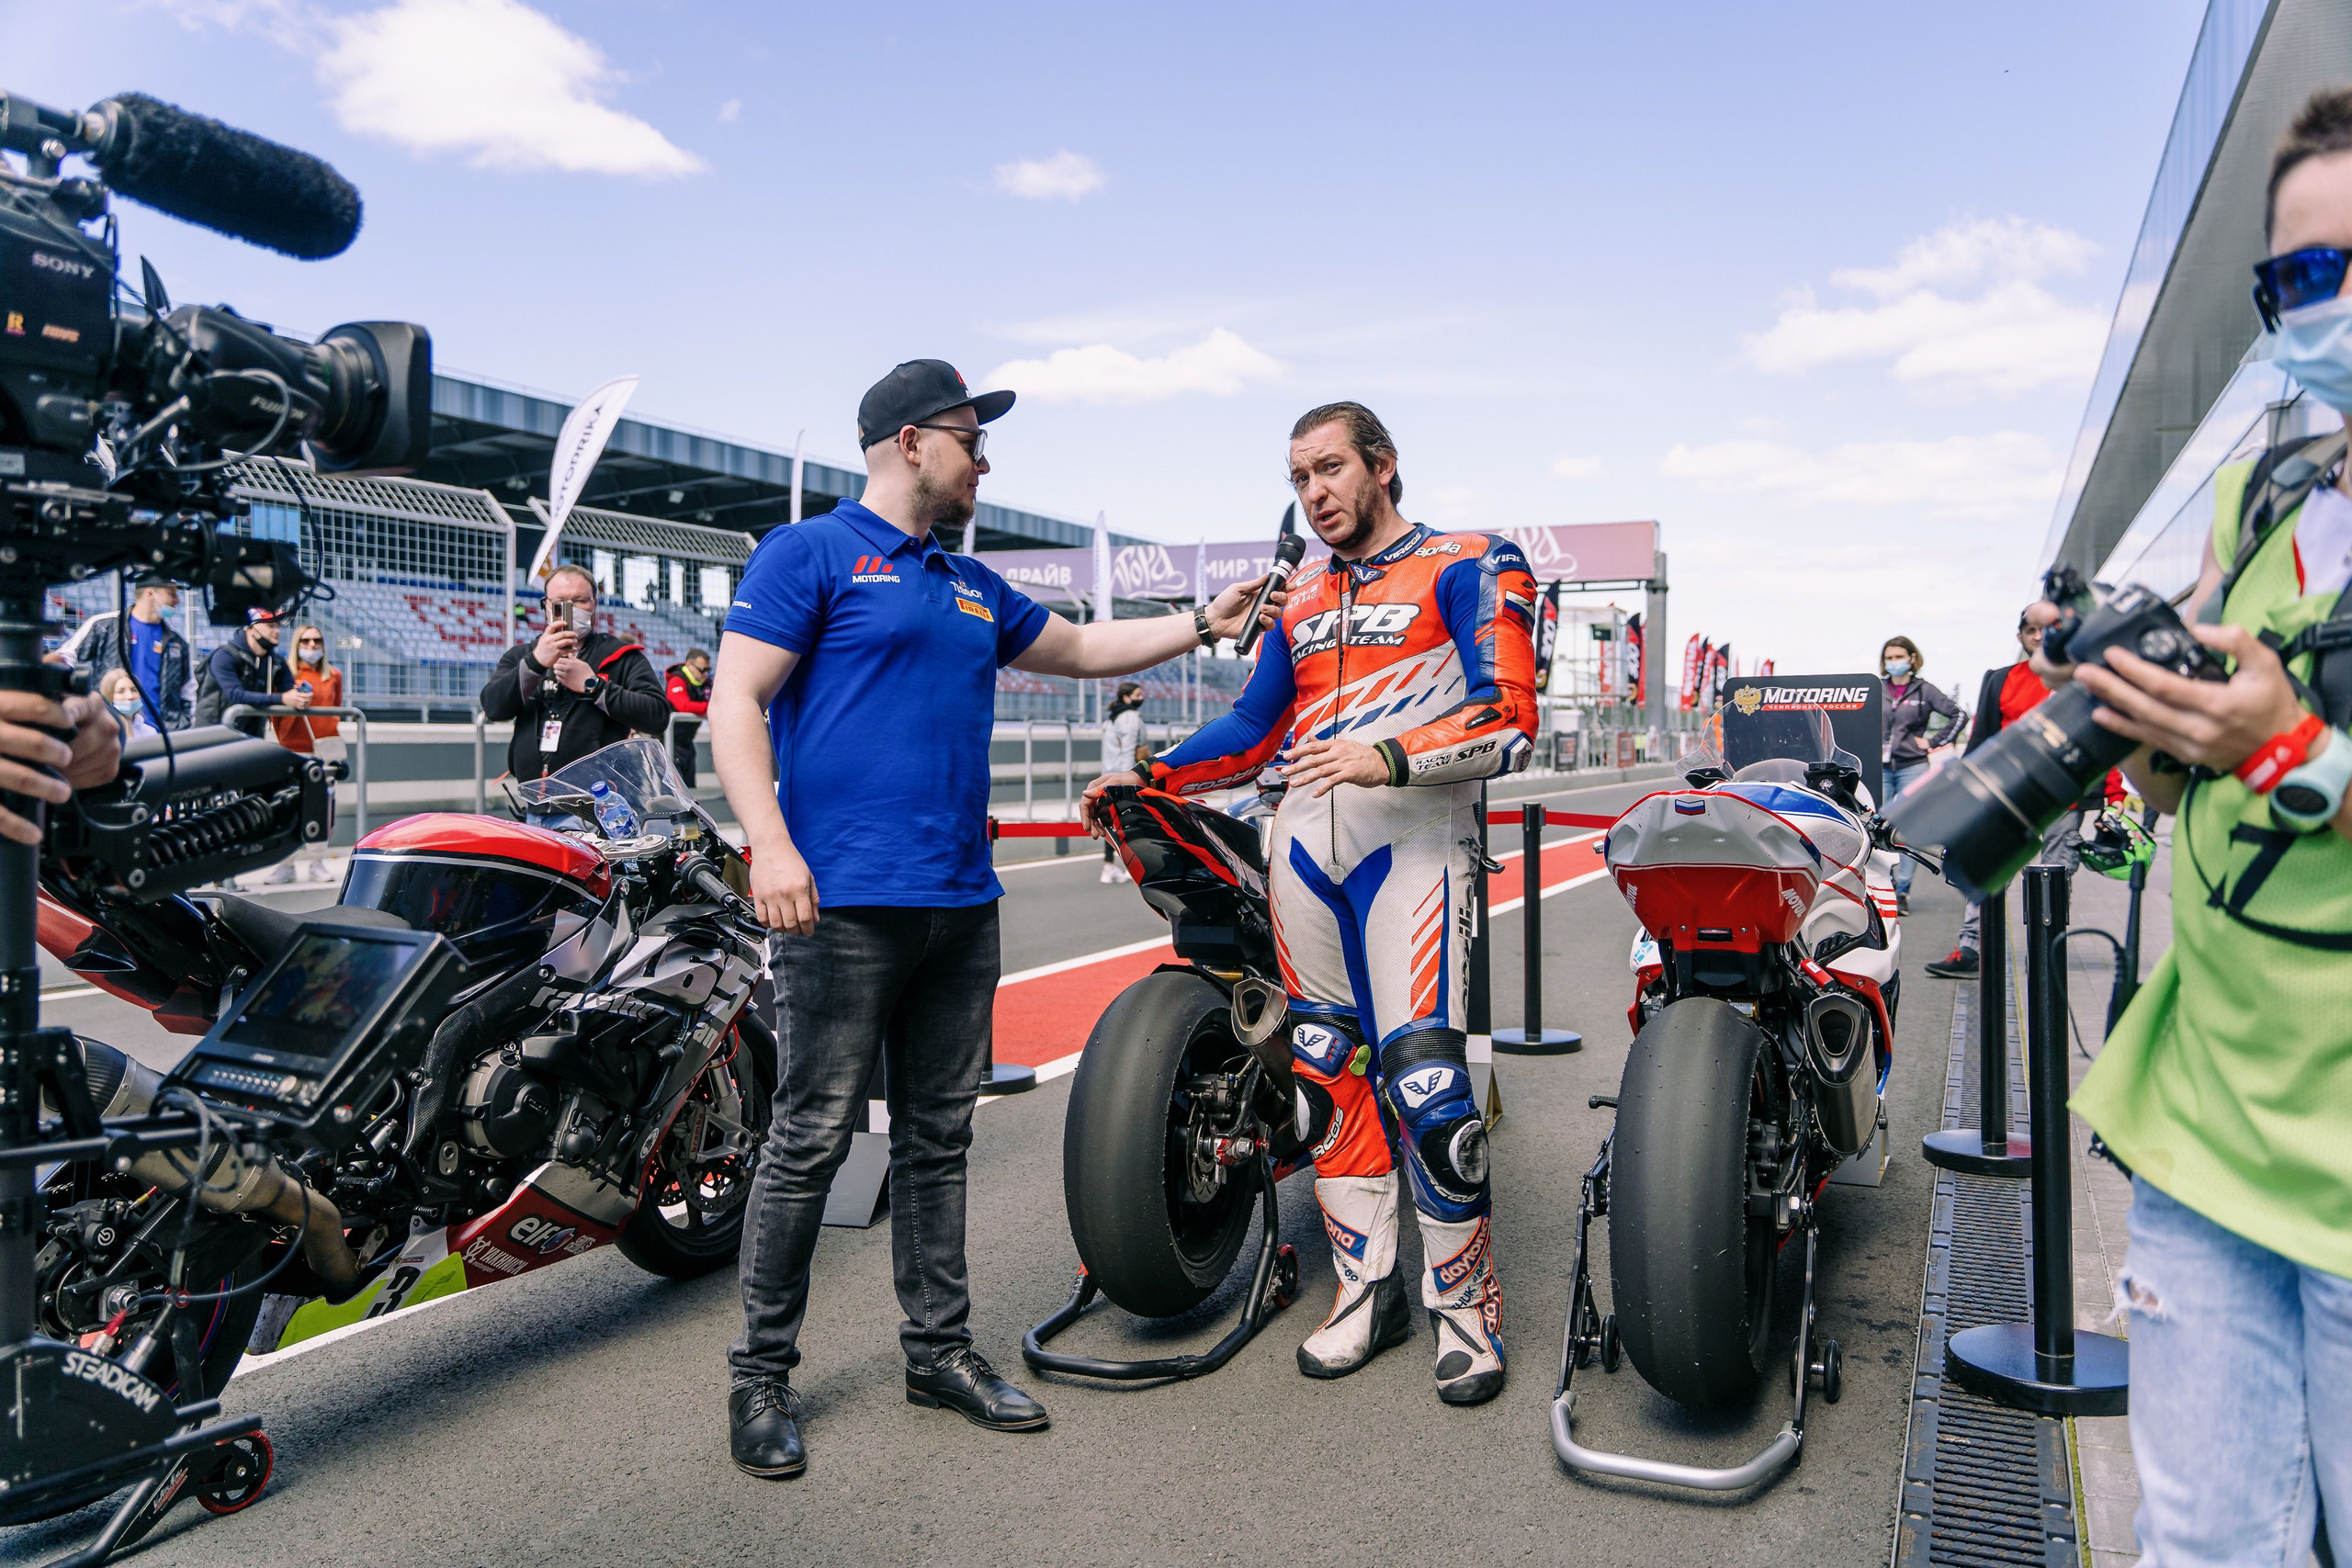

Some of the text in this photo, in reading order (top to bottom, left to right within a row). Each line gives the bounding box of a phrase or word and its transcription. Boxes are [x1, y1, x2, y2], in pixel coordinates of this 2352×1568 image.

[32, 251, 95, 279] SONY
[250, 395, 307, 420] FUJION
[1384, 532, 1422, 562] VIRCOS
[1414, 541, 1463, 558] aprilia
[853, 574, 900, 584] MOTORING
[1006, 562, 1072, 585] ДРАЙВ
[1204, 558, 1250, 580] МИР
[949, 581, 984, 601] TISSOT
[958, 599, 990, 619] PIRELLI
[1291, 603, 1421, 654] SPB
[1349, 635, 1406, 646] TEAM
[1763, 687, 1870, 704] MOTORING
[1416, 753, 1452, 765] RACING
[1455, 740, 1497, 762] SPB
[1419, 759, 1450, 771] TEAM
[1781, 887, 1807, 918] MOTUL
[691, 1112, 705, 1153] brembo
[1311, 1105, 1345, 1160] IRCOS
[511, 1217, 561, 1247] elf
[480, 1246, 528, 1276] YAKHNICH
[1440, 1217, 1488, 1284] daytona
[61, 1351, 161, 1415] STEADICAM
